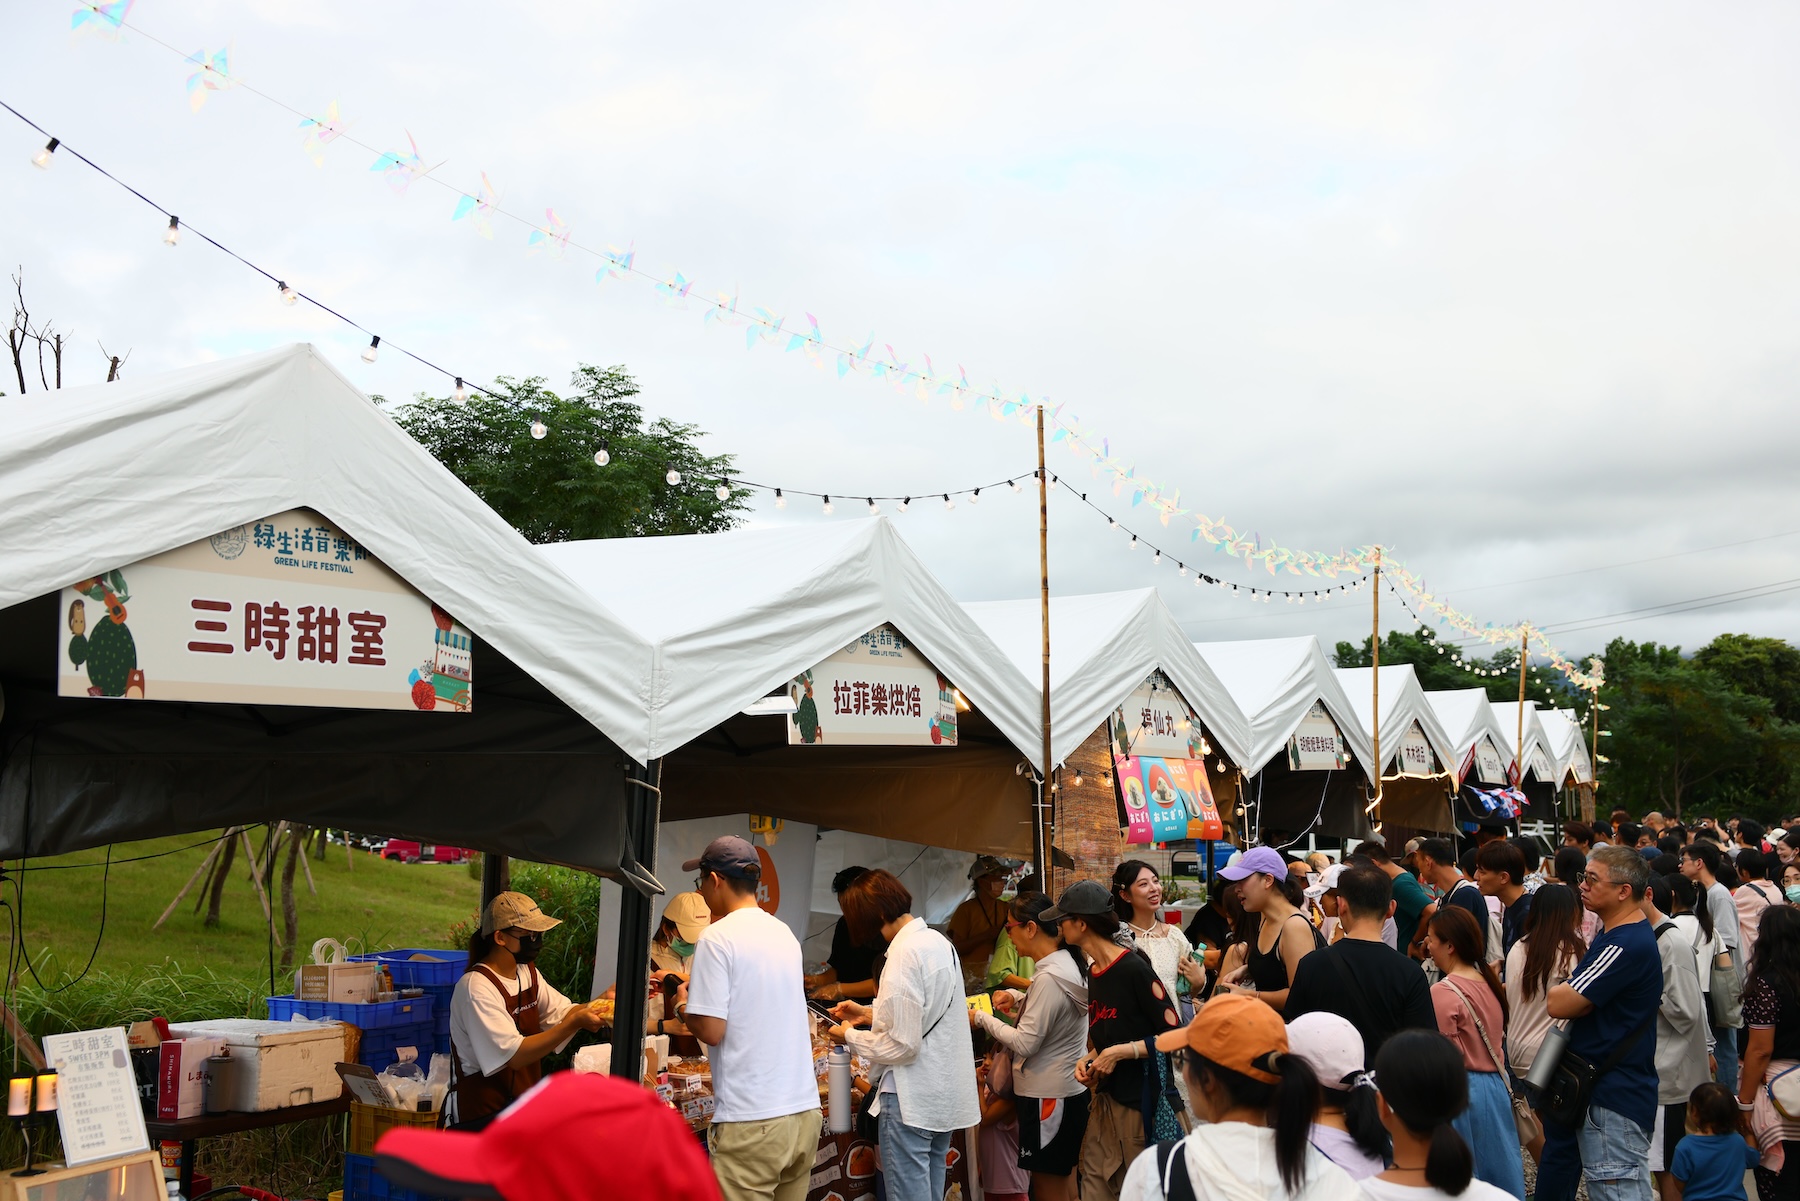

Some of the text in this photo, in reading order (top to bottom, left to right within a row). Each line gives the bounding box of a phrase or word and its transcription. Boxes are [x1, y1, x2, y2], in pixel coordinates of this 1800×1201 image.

[274, 556, 299, 567] GREEN
[187, 598, 388, 667] 三時甜室
[833, 679, 922, 718] 拉菲樂烘焙
[1153, 808, 1184, 822] おにぎり
[60, 1034, 115, 1053] 三時甜室
[68, 1051, 110, 1063] SWEET 3PM
